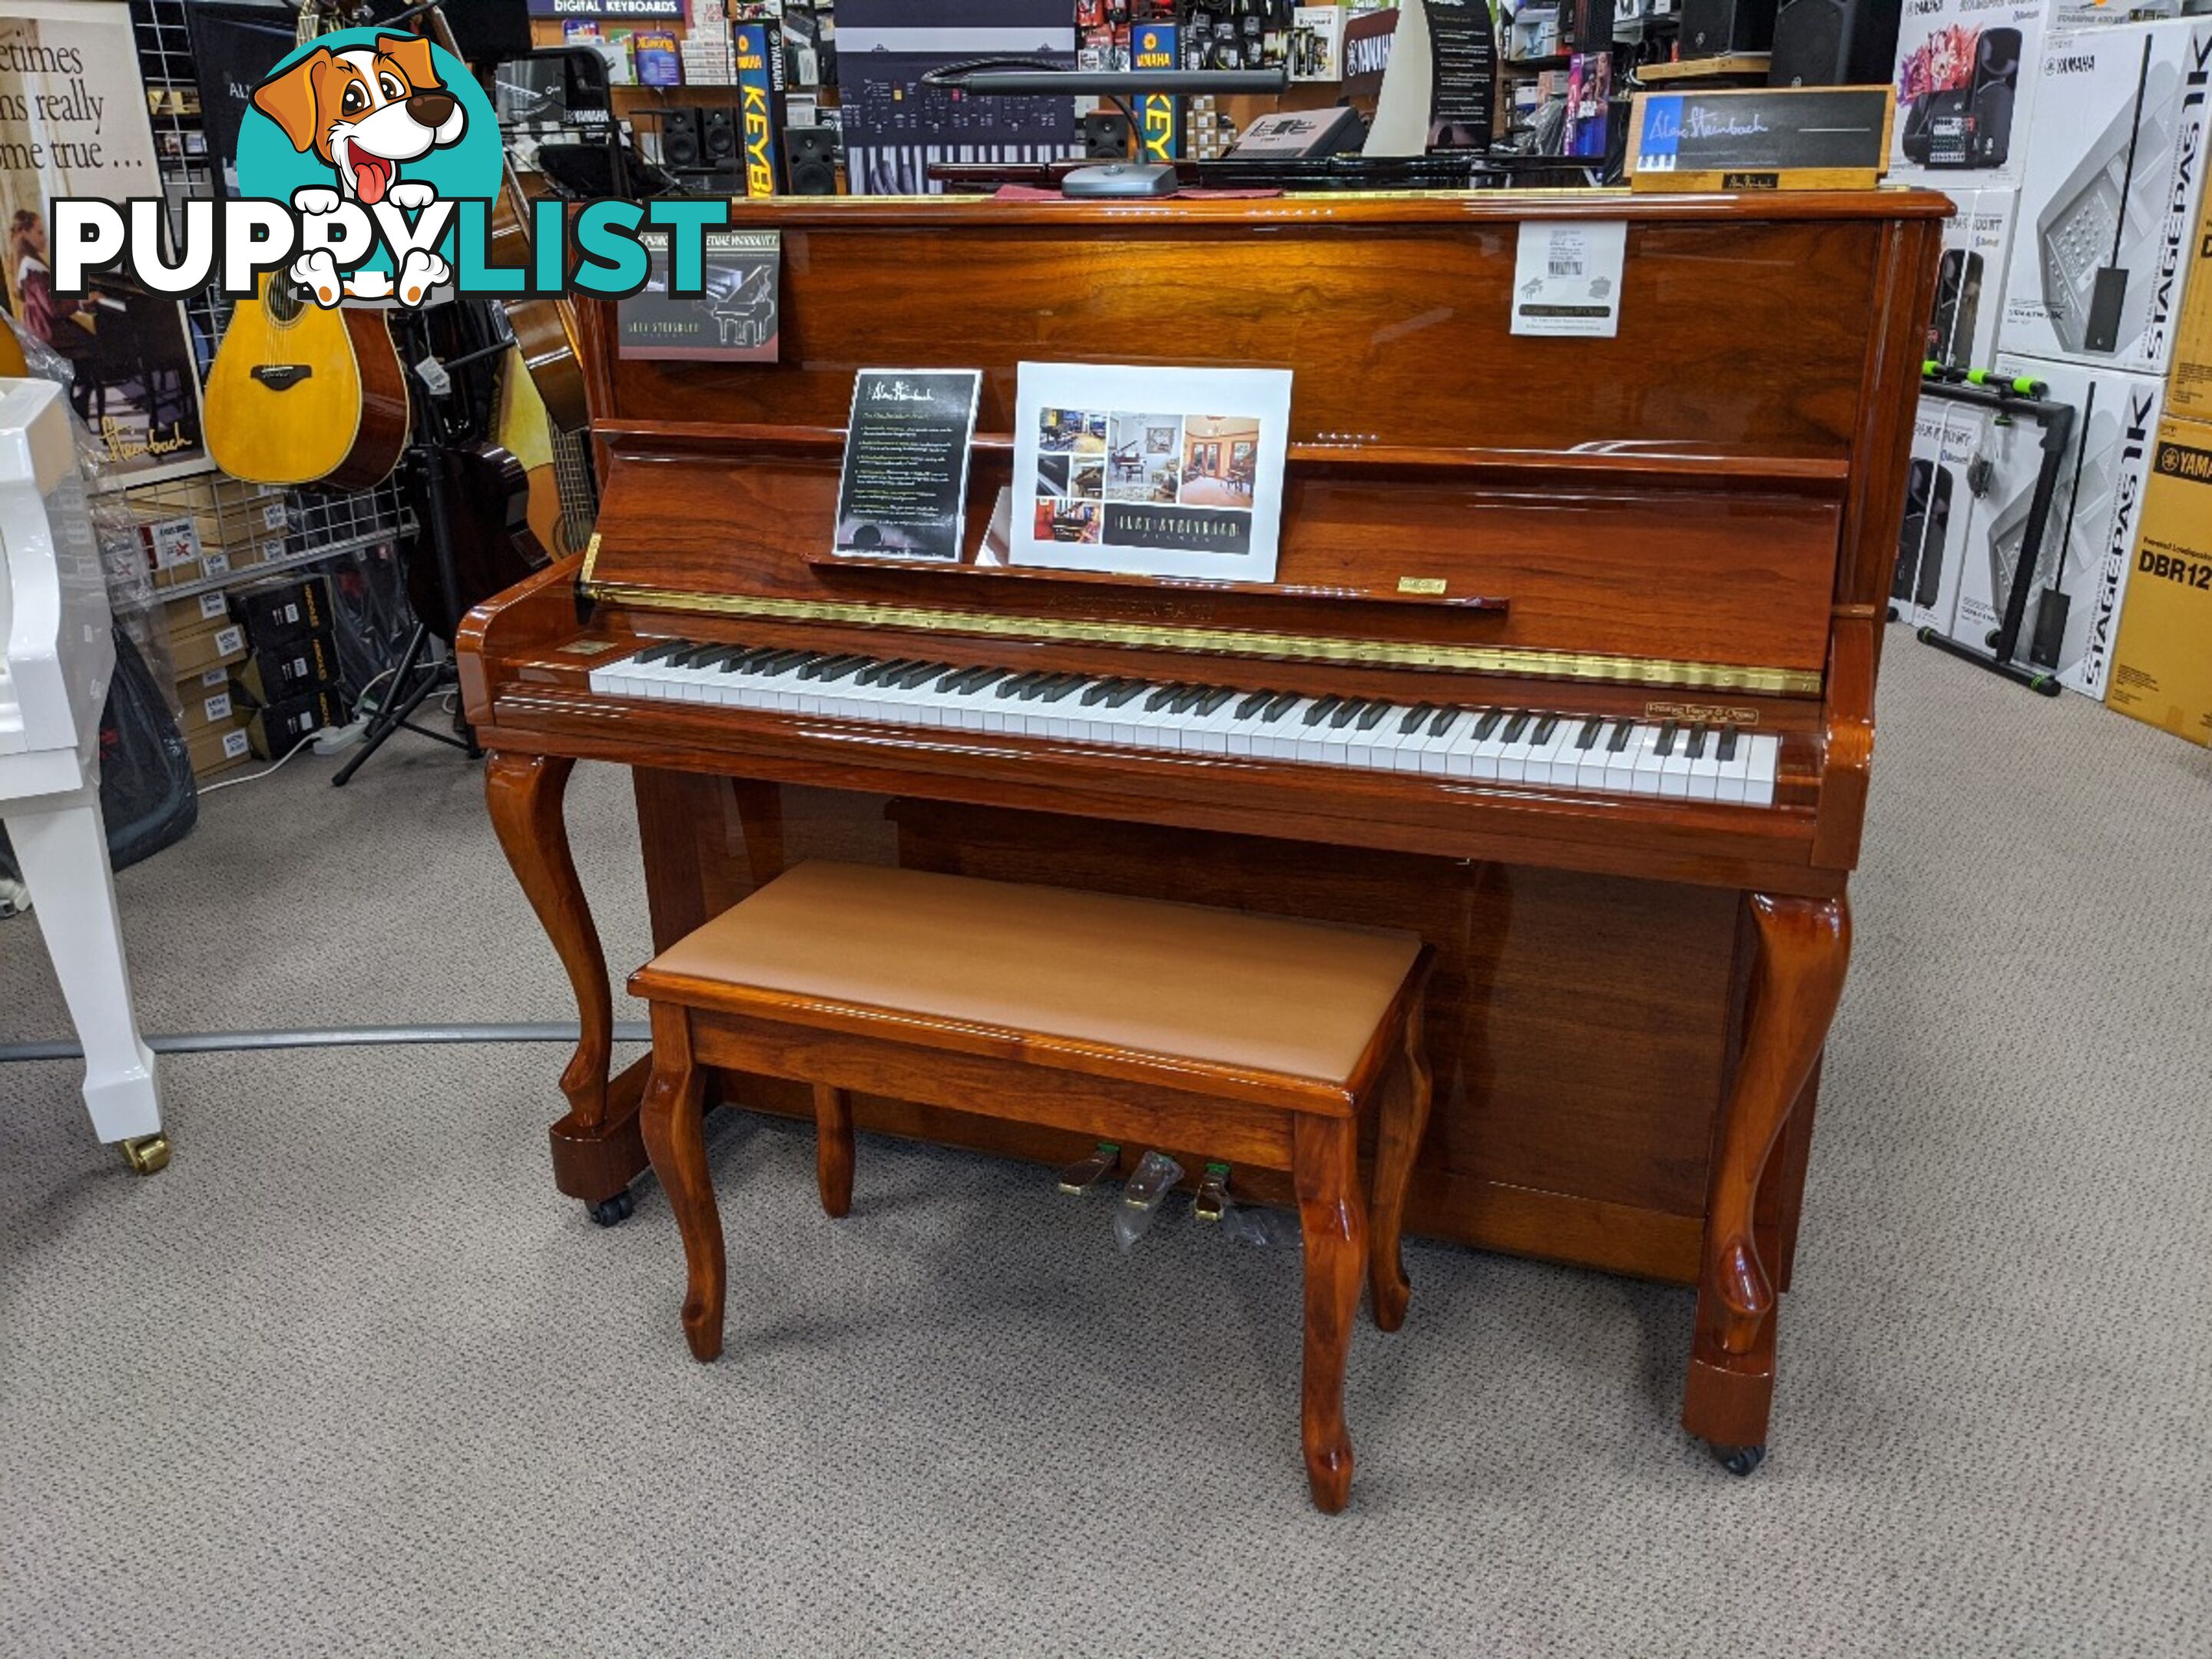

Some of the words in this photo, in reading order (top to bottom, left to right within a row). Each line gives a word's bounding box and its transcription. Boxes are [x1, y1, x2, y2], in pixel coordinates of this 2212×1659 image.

[554, 0, 601, 12] DIGITAL
[606, 0, 677, 13] KEYBOARDS
[770, 45, 785, 91] YAMAHA
[1137, 52, 1171, 68] YAMAHA
[2056, 55, 2095, 75] YAMAHA
[35, 78, 104, 135] really
[1649, 110, 1689, 141] Alex
[1686, 106, 1769, 138] Steinbach
[0, 143, 45, 170] me
[50, 140, 104, 168] true
[2146, 121, 2200, 361] STAGEPAS
[100, 416, 192, 462] Steinbach
[2085, 473, 2137, 687] STAGEPAS
[2121, 390, 2154, 465] 1K
[2138, 549, 2210, 591] DBR12
